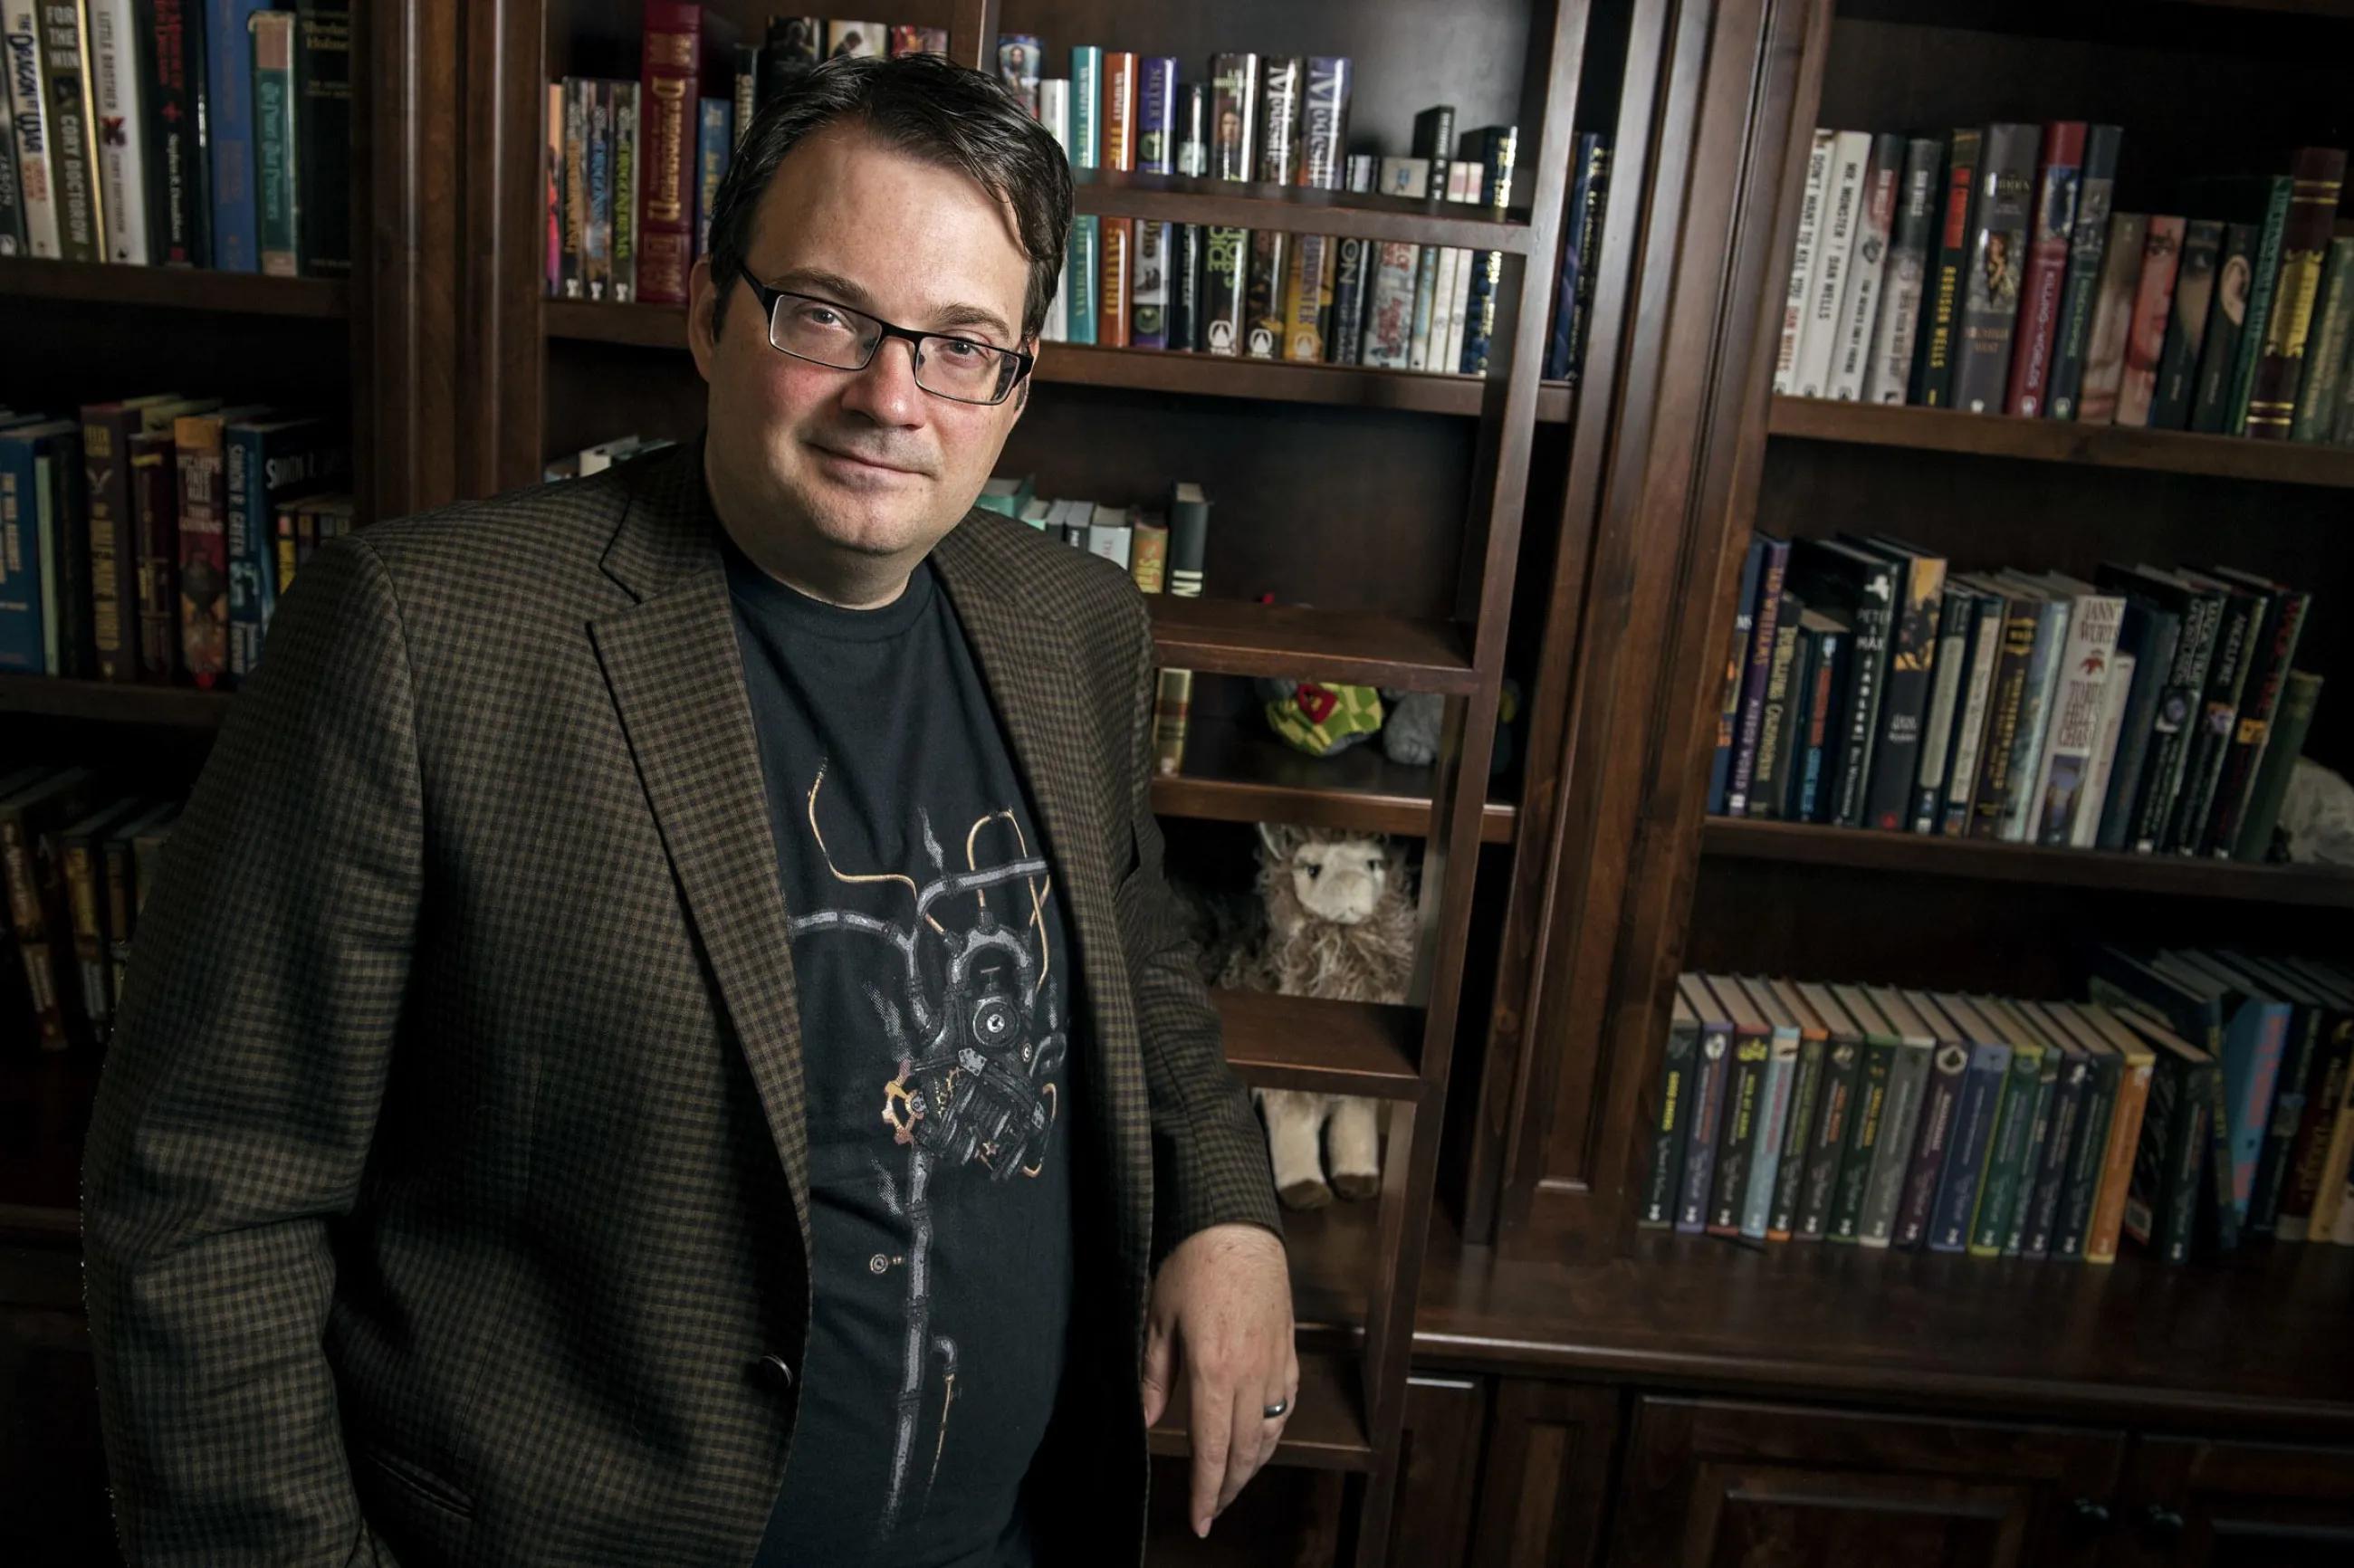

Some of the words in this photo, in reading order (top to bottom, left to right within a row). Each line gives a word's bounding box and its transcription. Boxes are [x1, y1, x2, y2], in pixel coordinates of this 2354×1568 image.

[46, 5, 76, 24] FOR
[97, 12, 113, 50] LITTLE
[48, 28, 78, 47] THE
[7, 34, 39, 97] DRAGON
[51, 49, 81, 68] WIN
[99, 54, 118, 110] BROTHER
[1148, 68, 1163, 120] MEYER
[14, 113, 44, 154] WAR
[60, 114, 81, 158] CORY
[1811, 154, 1827, 190] DON'T
[1880, 169, 1894, 187] DAN
[1914, 170, 1928, 188] DAN
[64, 159, 89, 244] DOCTOROW
[1804, 195, 1822, 227] WANT
[1833, 186, 1855, 239] MONSTER
[1874, 188, 1891, 216] WELLS
[1910, 189, 1926, 217] WELLS
[1793, 248, 1810, 273] KILL
[1827, 255, 1843, 282] DAN
[1818, 283, 1839, 321] WELLS
[1937, 265, 1958, 324] ROBISON
[2040, 271, 2058, 323] KILLING
[1785, 305, 1802, 330] DAN
[1777, 334, 1796, 373] WELLS
[1929, 327, 1949, 368] WELLS
[2027, 332, 2049, 388] WORLDS
[227, 443, 246, 492] SIMON
[1754, 595, 1781, 665] WILLIAMS
